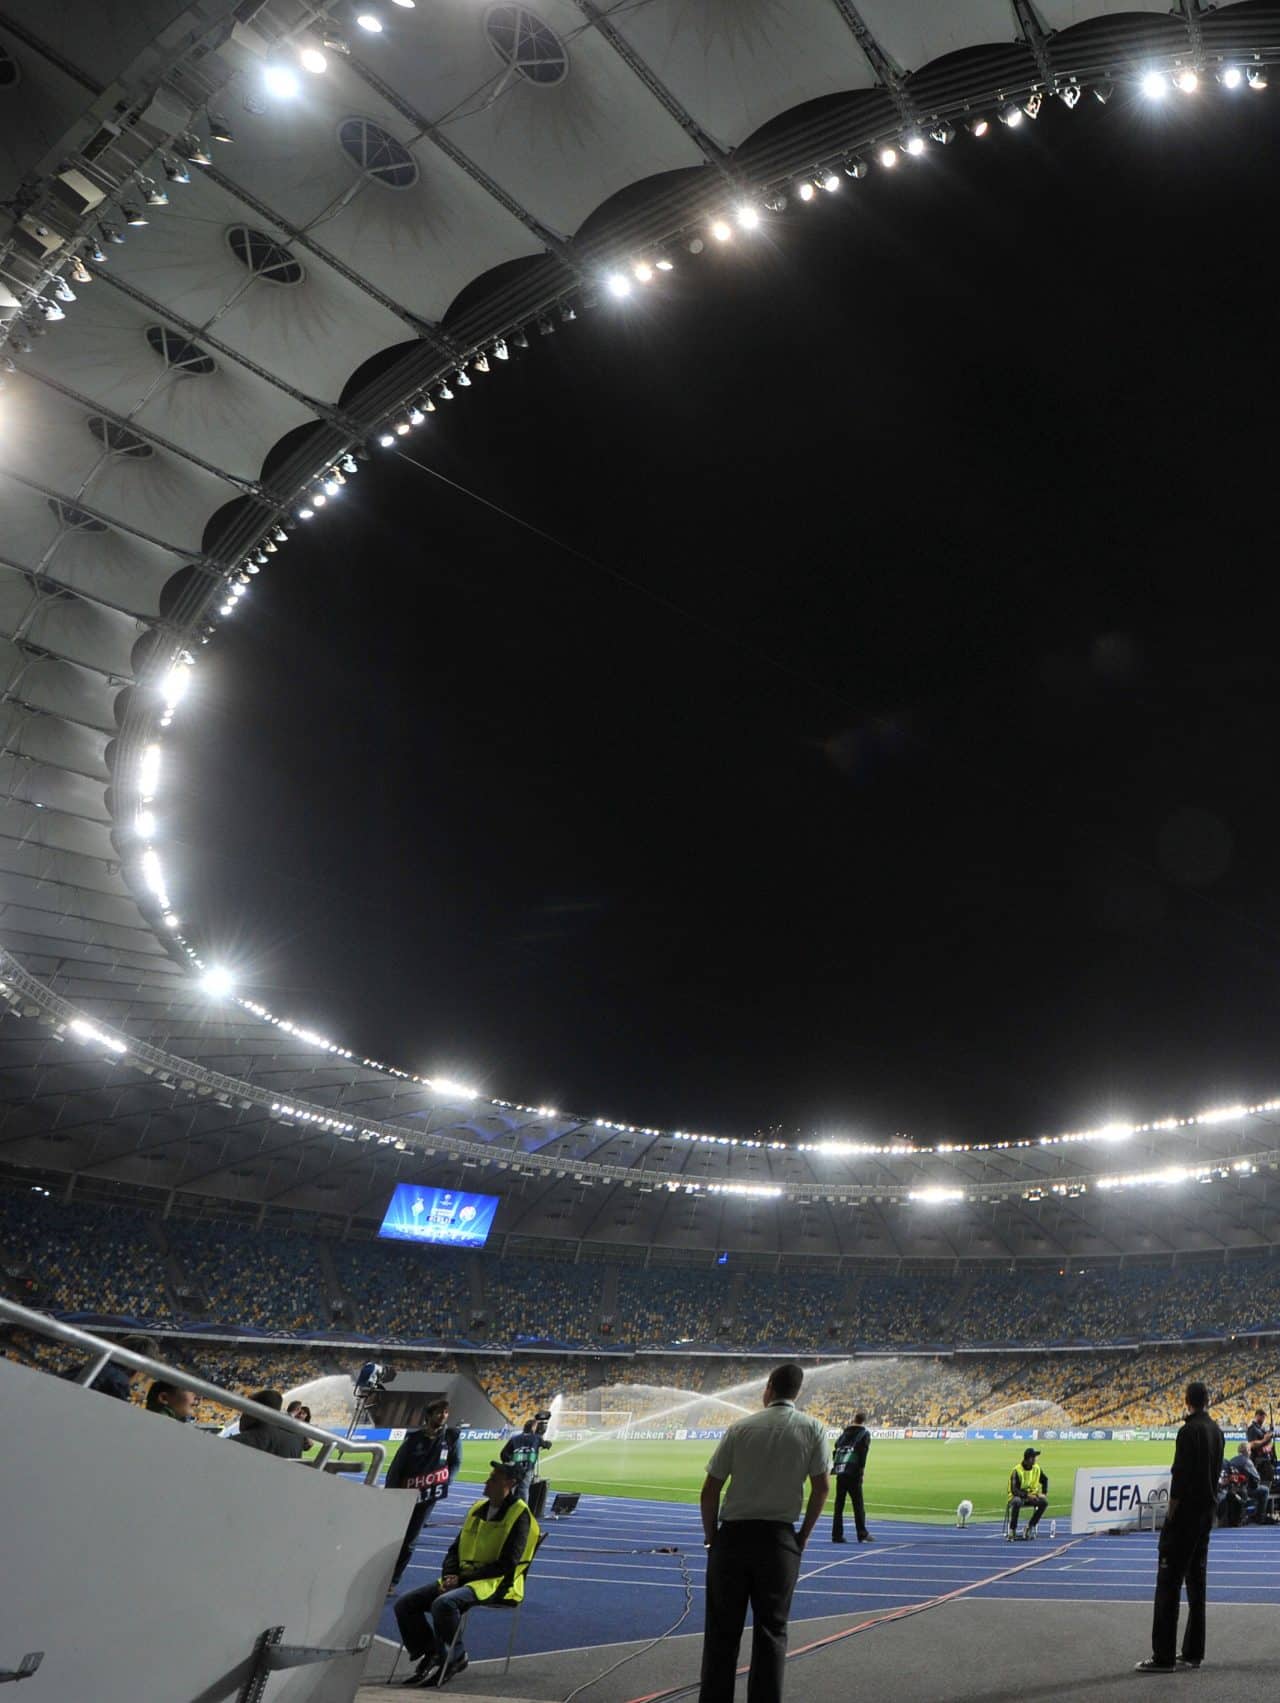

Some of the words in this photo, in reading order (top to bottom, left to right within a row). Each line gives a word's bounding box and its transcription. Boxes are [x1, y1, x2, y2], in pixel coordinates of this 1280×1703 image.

[468, 1430, 501, 1440] Furthe
[616, 1429, 664, 1440] Heineken
[406, 1468, 449, 1489] PHOTO
